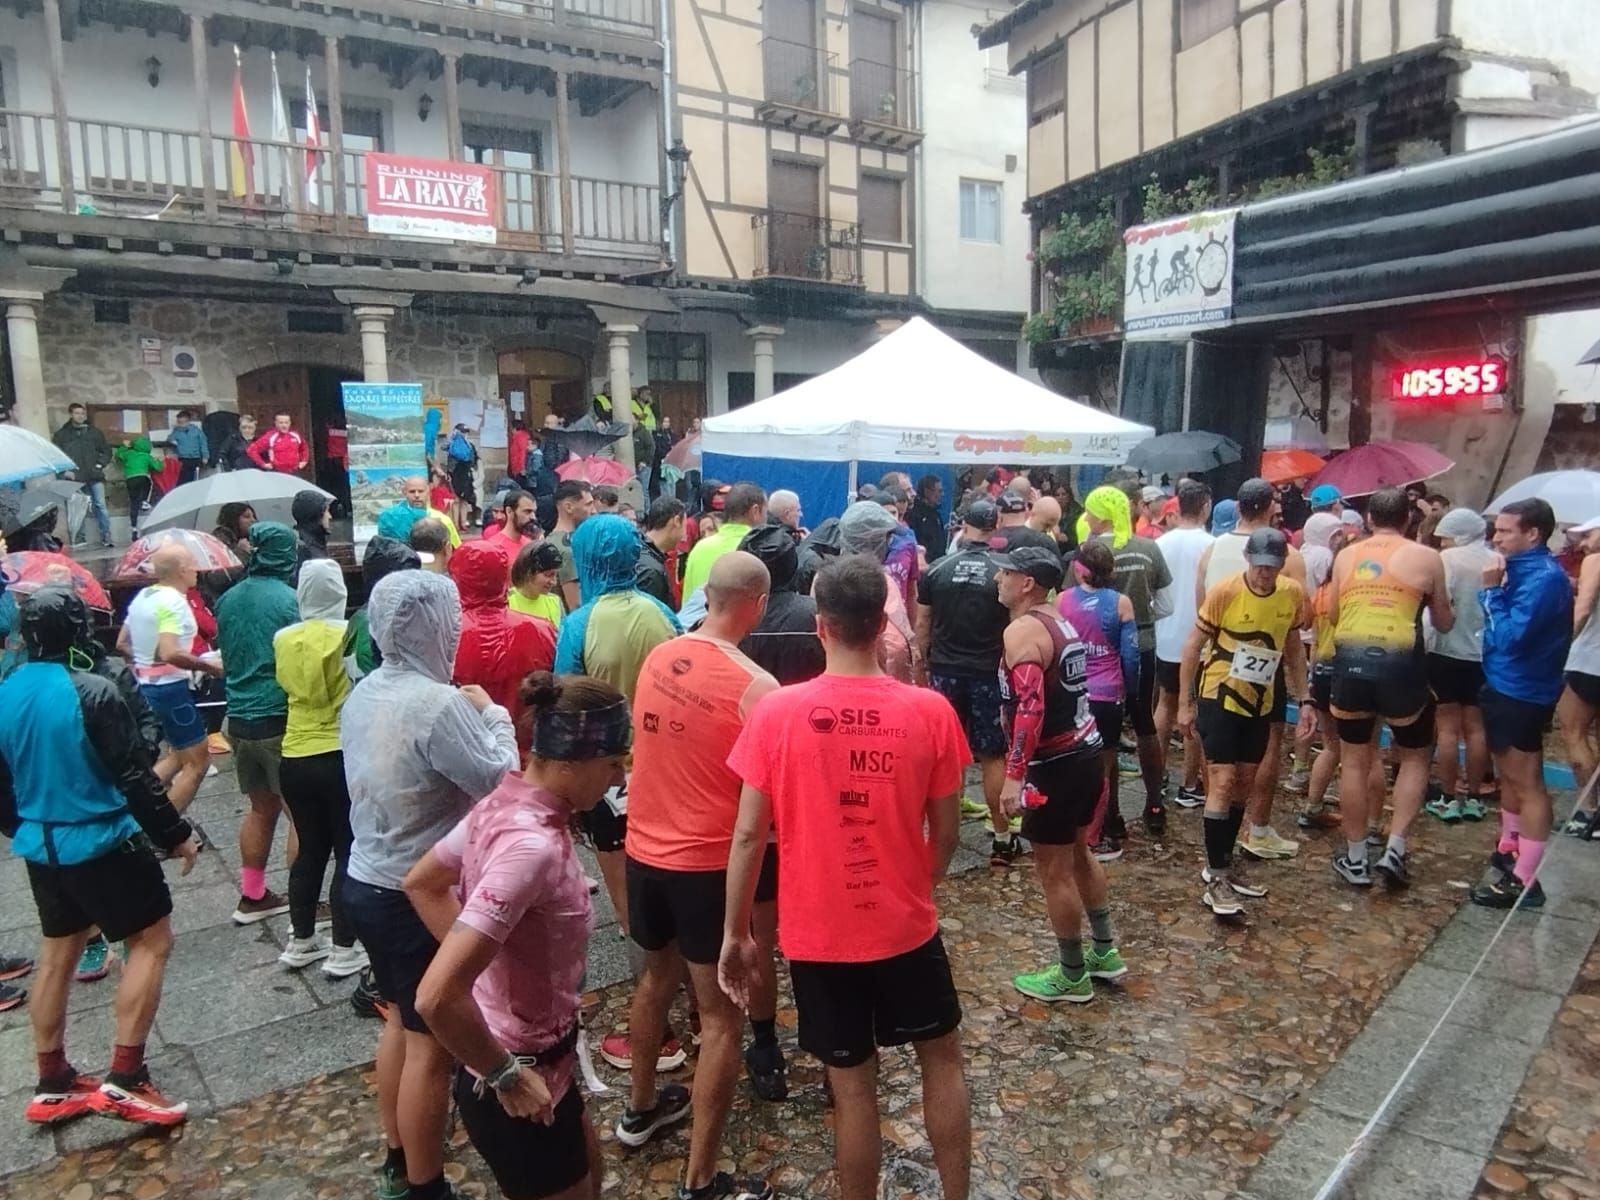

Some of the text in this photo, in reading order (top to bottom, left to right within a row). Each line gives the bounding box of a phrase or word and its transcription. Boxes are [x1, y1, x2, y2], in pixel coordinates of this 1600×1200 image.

[377, 164, 479, 182] RUNNING
[378, 175, 482, 210] LA RAYA
[1244, 656, 1269, 673] 27
[840, 708, 881, 726] SIS
[838, 726, 908, 738] CARBURANTES
[850, 749, 894, 774] MSC
